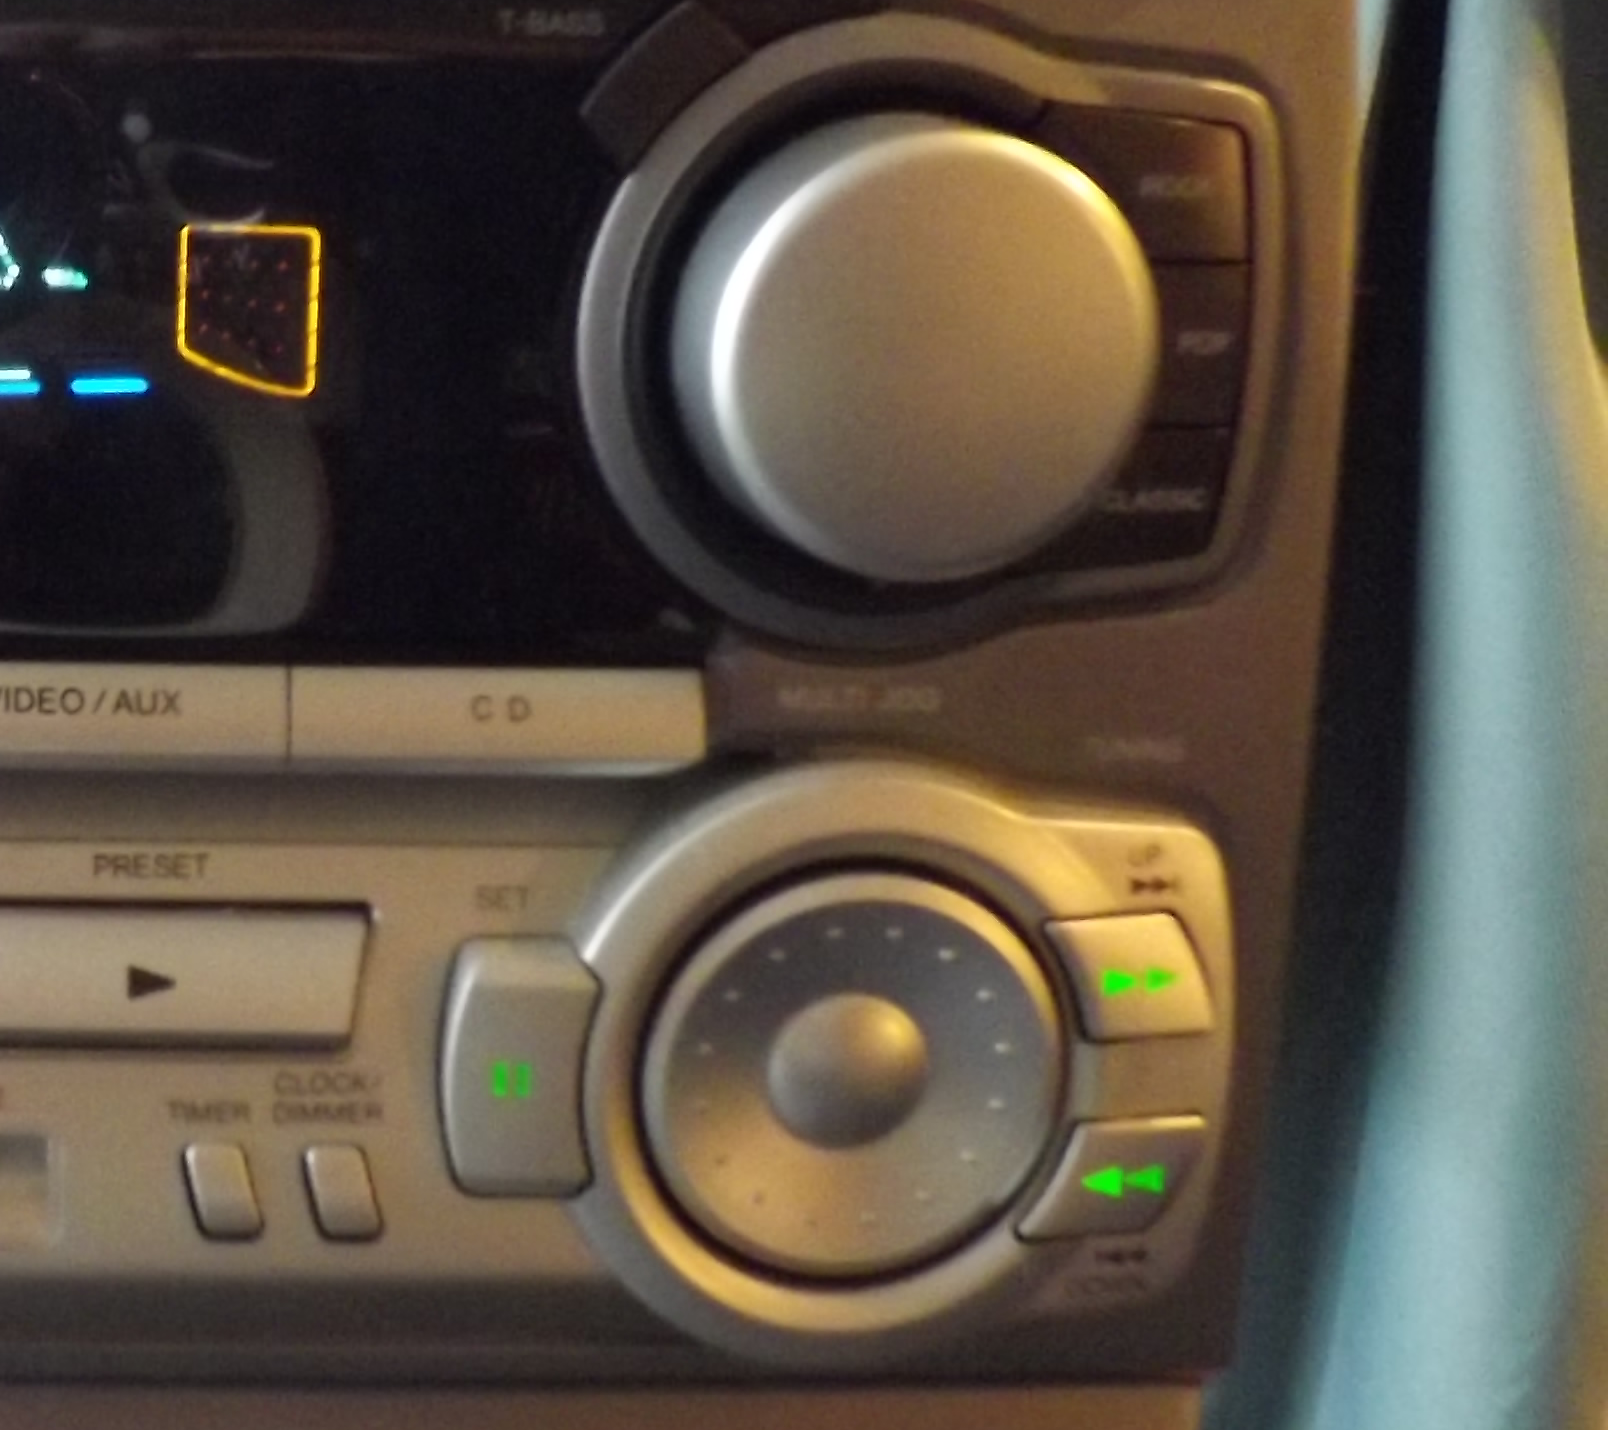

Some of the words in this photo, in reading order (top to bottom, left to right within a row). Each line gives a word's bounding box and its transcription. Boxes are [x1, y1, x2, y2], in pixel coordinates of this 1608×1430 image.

[92, 853, 208, 879] PRESET
[476, 886, 529, 911] SET
[167, 1100, 252, 1124] TIMER
[272, 1099, 383, 1125] DIMMER
